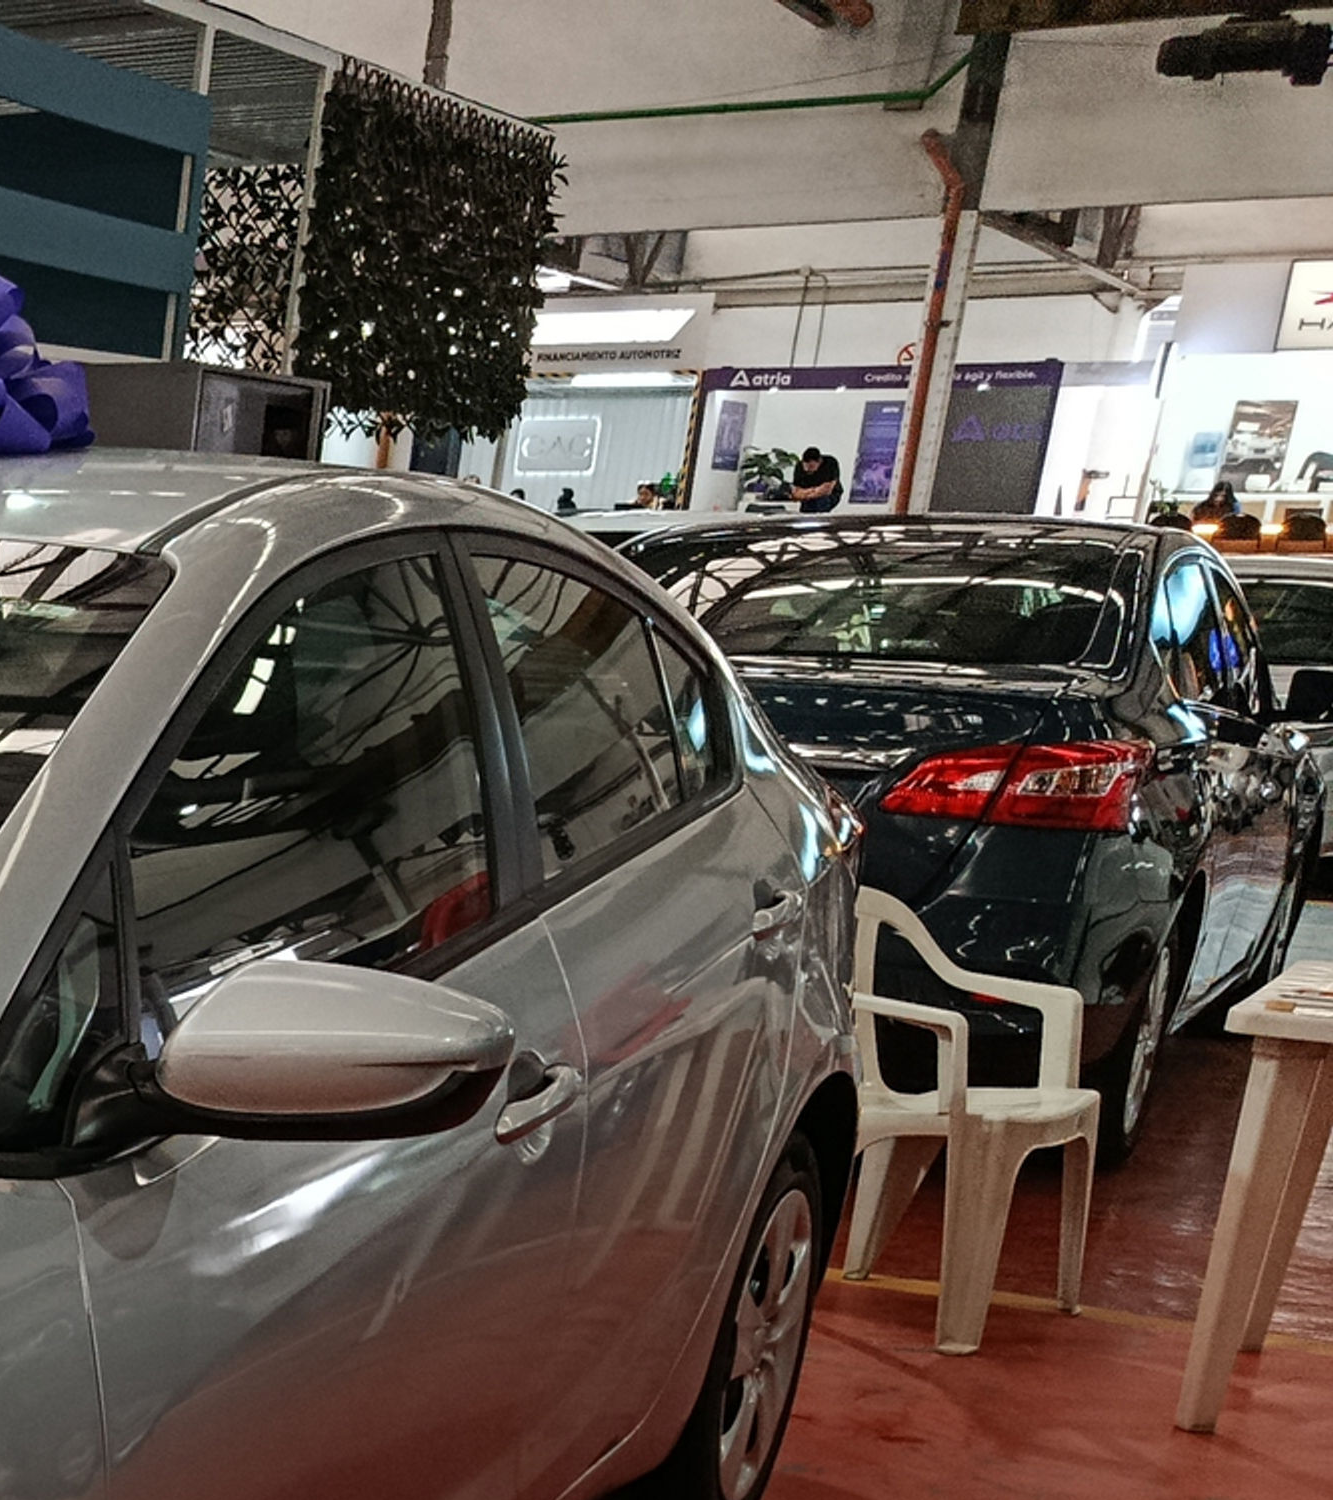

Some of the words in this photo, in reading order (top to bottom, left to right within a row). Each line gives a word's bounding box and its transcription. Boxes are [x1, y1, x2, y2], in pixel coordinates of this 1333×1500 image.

[537, 350, 616, 363] FINANCIAMIENTO
[620, 348, 682, 361] AUTOMOTRIZ
[752, 371, 791, 386] atria
